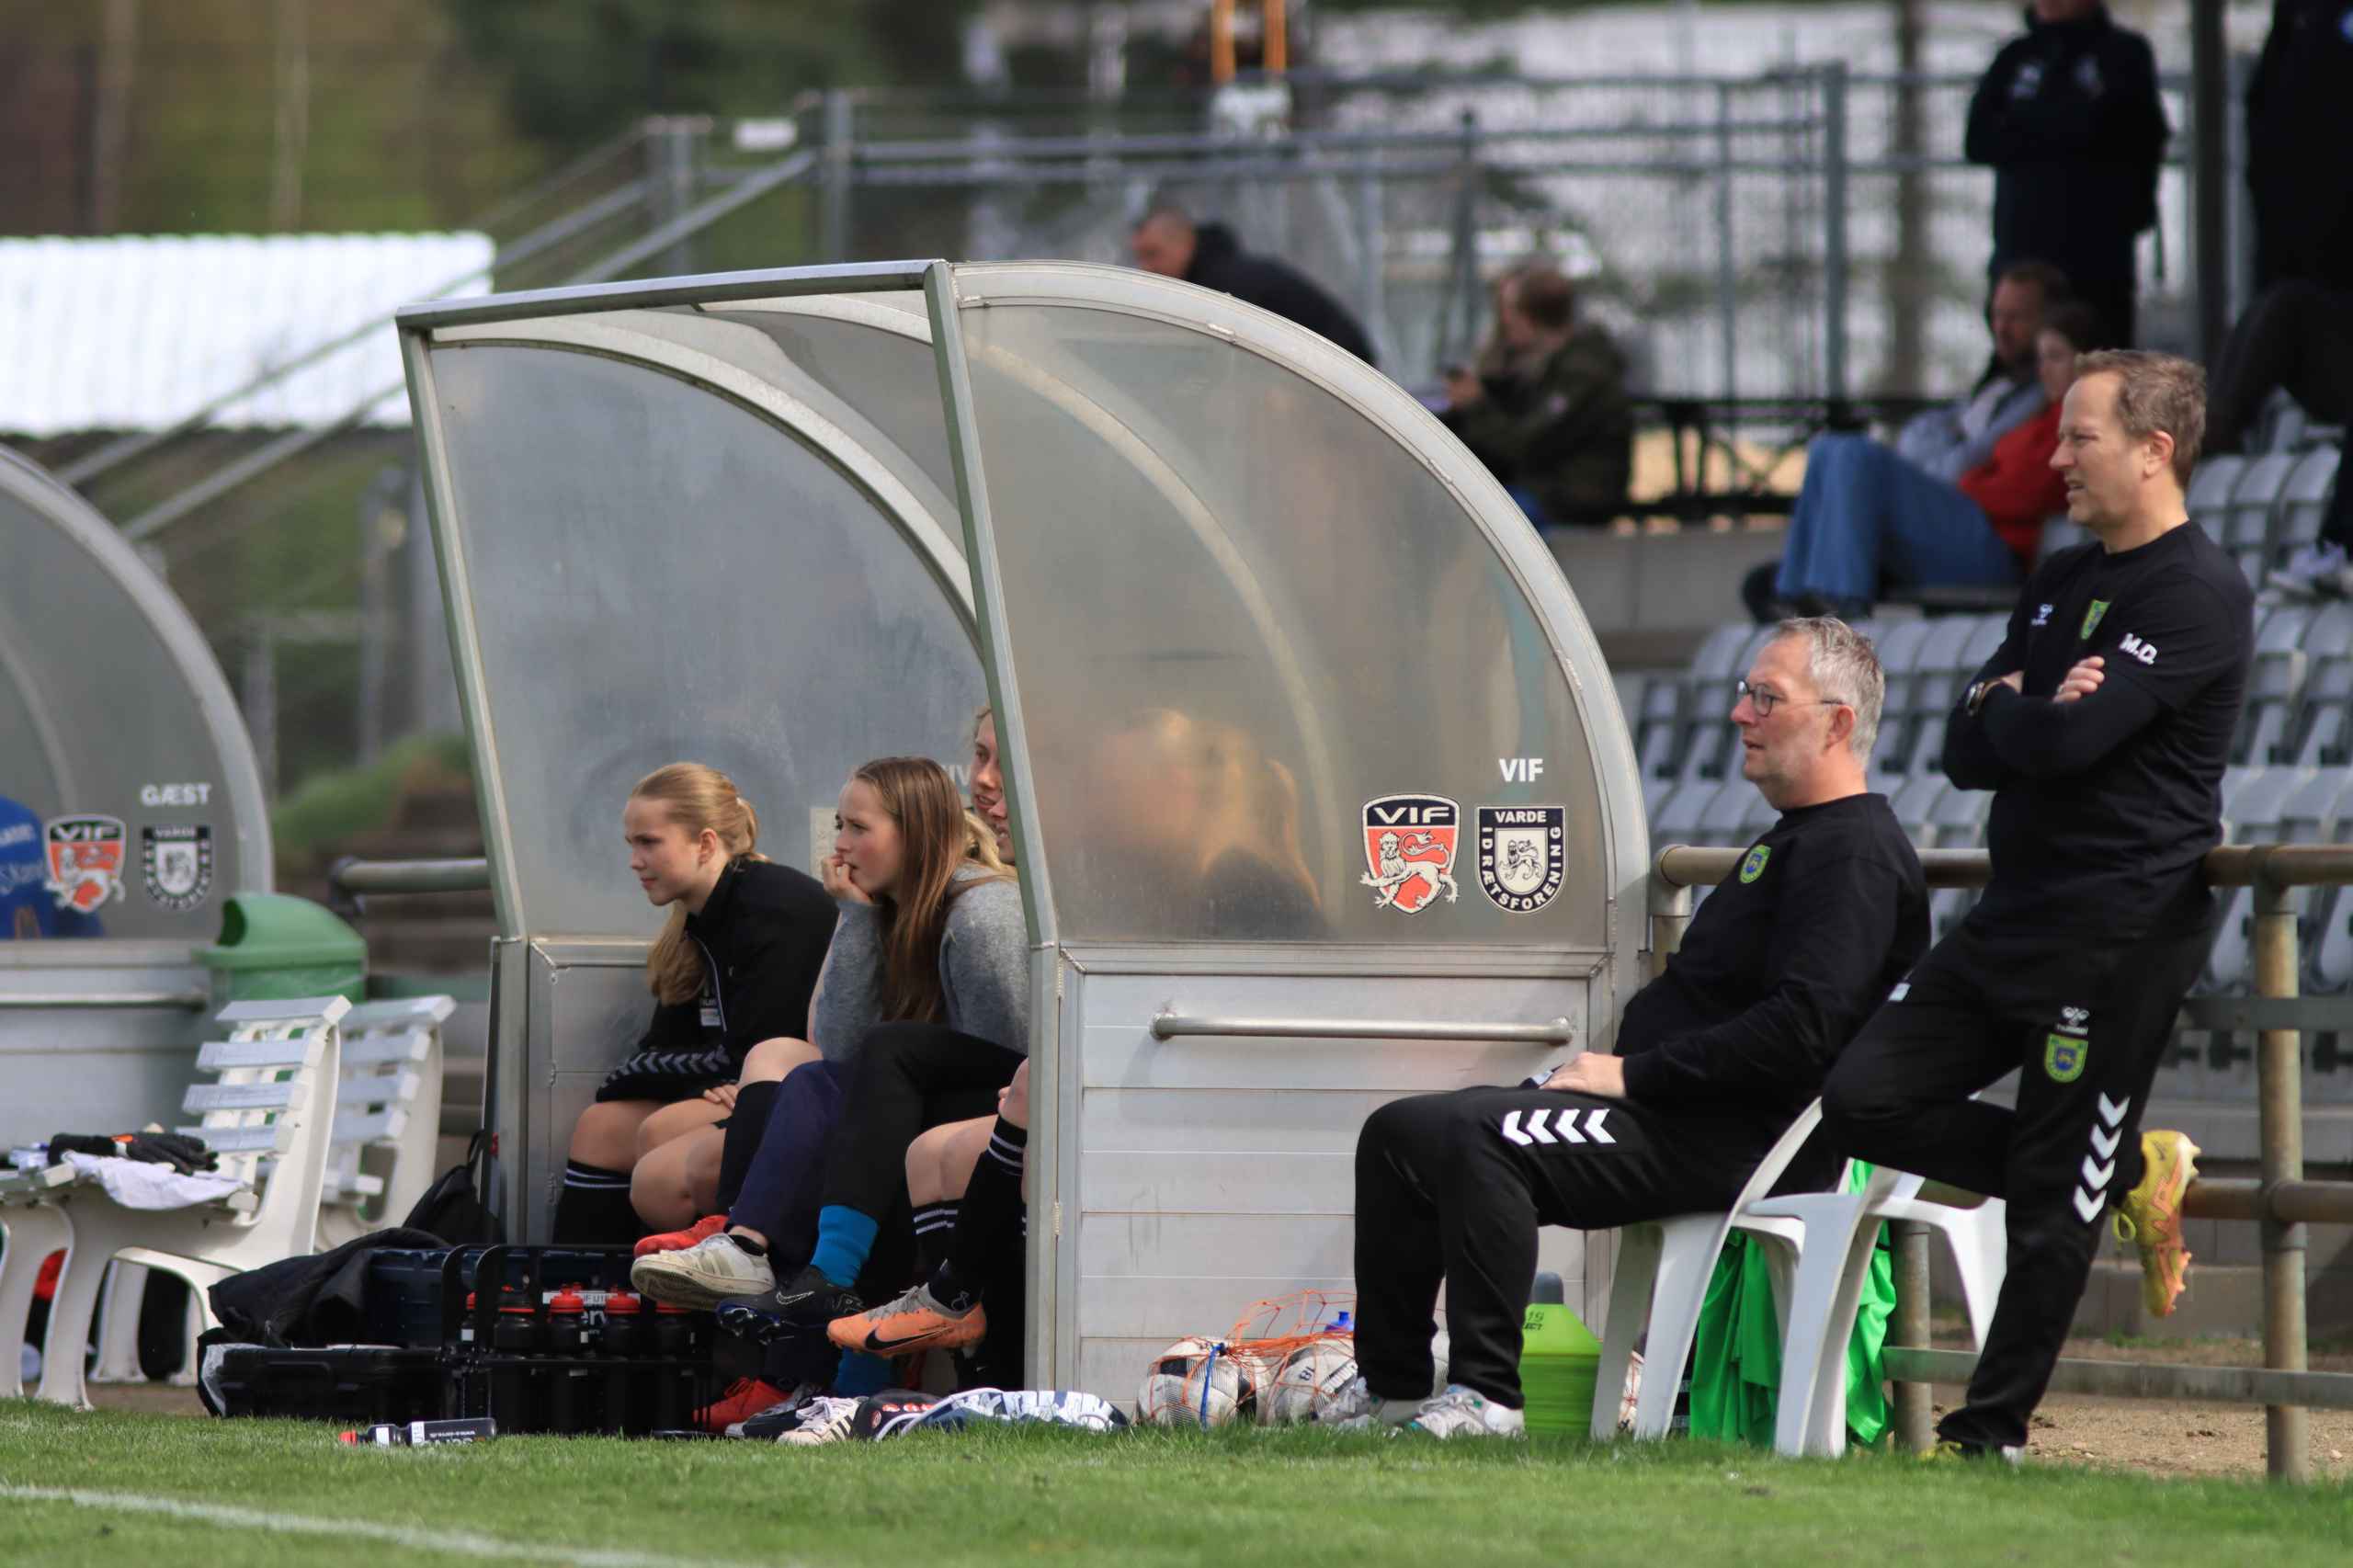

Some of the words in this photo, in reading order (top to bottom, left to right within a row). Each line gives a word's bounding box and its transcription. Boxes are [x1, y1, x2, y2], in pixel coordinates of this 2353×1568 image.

[1499, 758, 1543, 782] VIF
[141, 783, 211, 806] GÆST
[1373, 807, 1449, 824] VIF
[1495, 811, 1547, 824] VARDE
[54, 825, 118, 841] VIF
[1481, 827, 1562, 910] IDRÆTSFORENING
